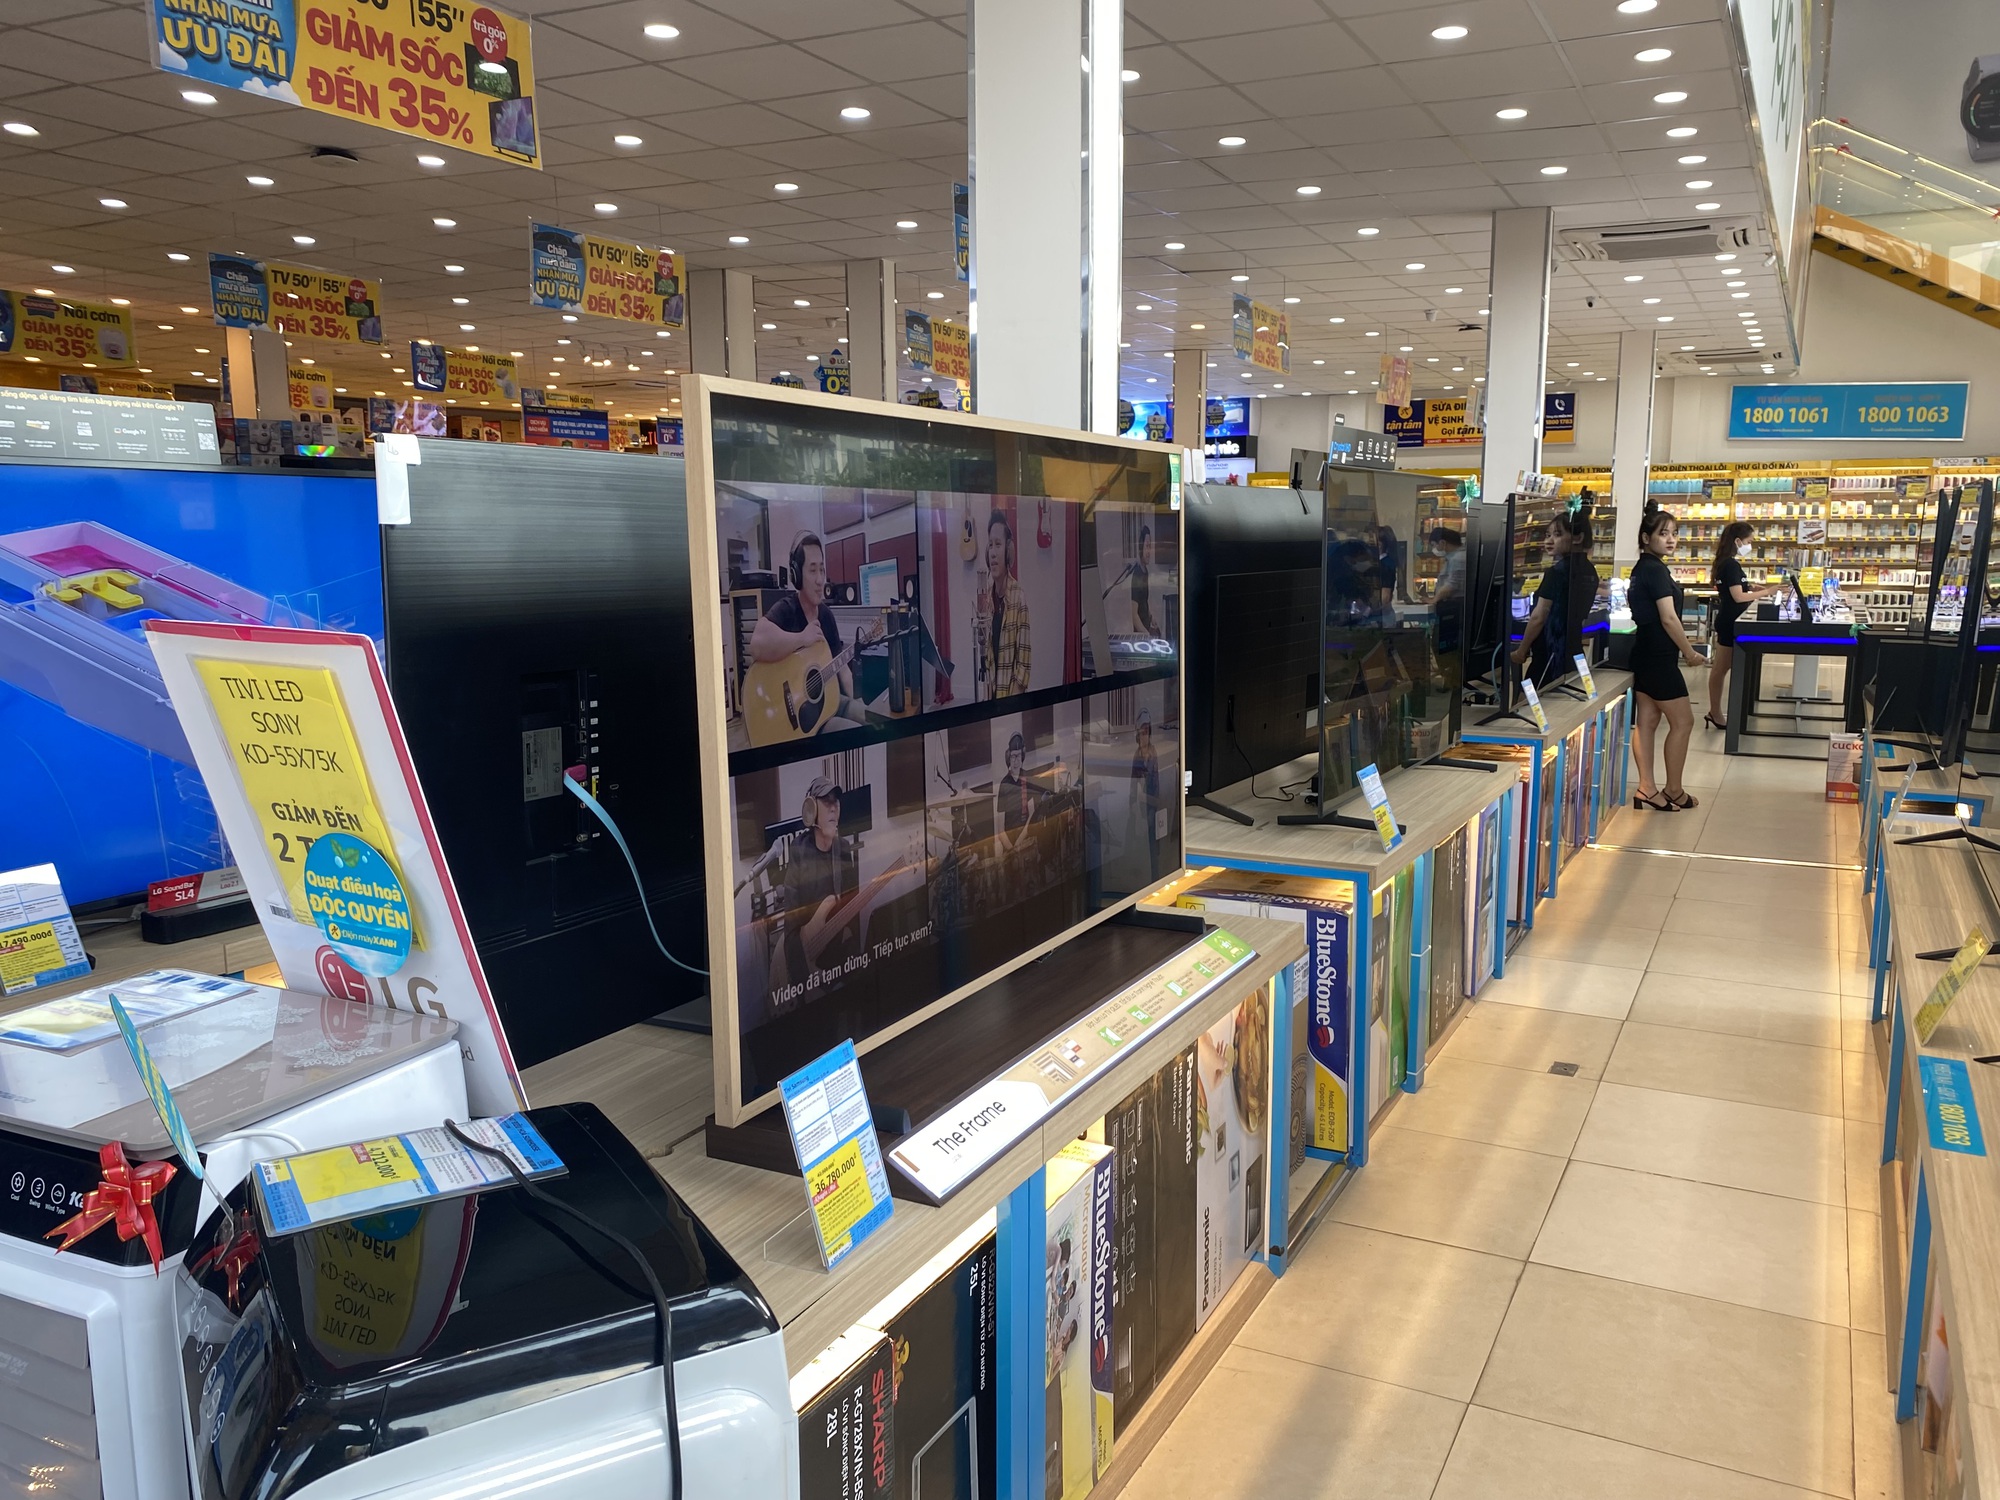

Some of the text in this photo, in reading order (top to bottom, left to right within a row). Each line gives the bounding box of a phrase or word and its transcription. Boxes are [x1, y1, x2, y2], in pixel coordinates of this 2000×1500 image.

[231, 6, 281, 39] MƯA
[163, 17, 287, 77] ƯU ĐÃI
[306, 8, 464, 86] GIẢM SỐC
[307, 65, 474, 144] ĐẾN 35%
[588, 242, 605, 259] TV
[271, 270, 290, 284] TV
[589, 264, 653, 294] GIẢM SỐC
[558, 284, 580, 301] ĐÃI
[313, 296, 344, 316] SỐC
[587, 292, 655, 322] ĐẾN 35%
[90, 311, 120, 324] cơm
[310, 316, 350, 340] 35%
[933, 322, 941, 334] TV
[22, 318, 94, 339] GIẢM SỐC
[55, 338, 97, 358] 35%
[449, 363, 494, 379] GIẢM SỐC
[482, 355, 496, 365] Nồi
[497, 358, 515, 367] cơm
[290, 369, 326, 382] Nồi cơm
[468, 379, 496, 395] 30%
[155, 403, 176, 411] Google
[1432, 401, 1452, 411] SỬA
[1743, 407, 1829, 424] 1800 1061
[1858, 406, 1949, 423] 1800 1063
[1386, 420, 1423, 433] tận tâm
[1428, 415, 1464, 425] VỆ SINH
[1441, 427, 1455, 436] Gọi
[220, 677, 304, 703] TIVI LED
[251, 711, 302, 735] SONY
[240, 743, 344, 773] KD-55X75K
[271, 798, 364, 832] GIẢM ĐẾN
[272, 832, 295, 863] 2
[175, 889, 195, 901] SL4
[306, 870, 402, 902] Quạt điều hoà
[309, 891, 409, 930] ĐỘC QUYỀN
[772, 921, 933, 1006] Video đã tạm dừng. Tiếp tục xem?
[1316, 916, 1337, 1026] BlueStone
[1185, 1052, 1195, 1165] Panasonic
[1327, 1090, 1335, 1111] Model:
[932, 1098, 1006, 1156] The Frame
[10, 1193, 20, 1201] Cool
[29, 1199, 41, 1208] Swing
[56, 1206, 66, 1215] Type
[1080, 1183, 1092, 1283] Microwave
[1094, 1163, 1111, 1340] BlueStone
[970, 1263, 979, 1297] 25L
[826, 1408, 838, 1448] 28L
[872, 1368, 886, 1488] SHARP
